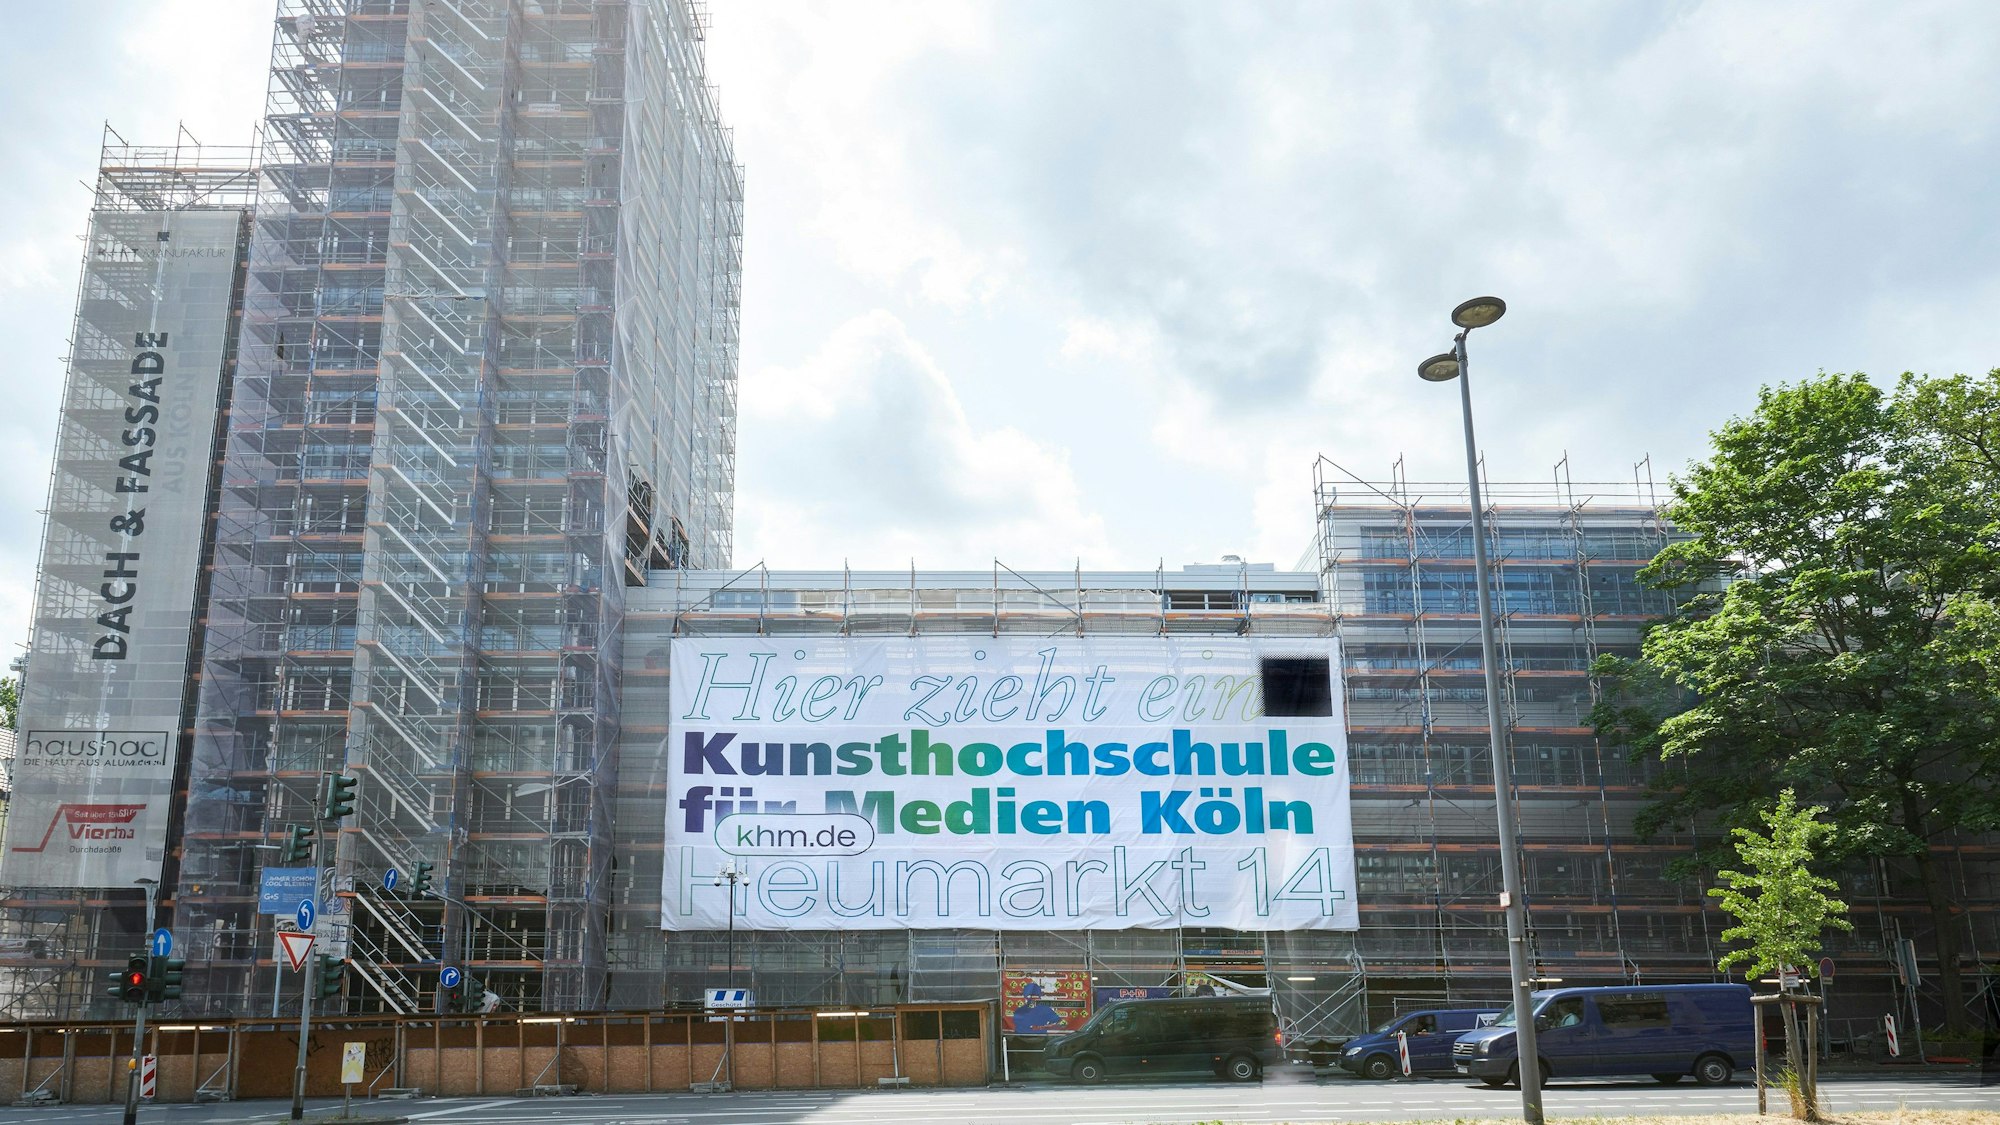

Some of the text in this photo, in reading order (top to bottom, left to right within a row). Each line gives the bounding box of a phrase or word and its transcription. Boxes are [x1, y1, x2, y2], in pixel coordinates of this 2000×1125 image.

[161, 371, 195, 495] AUS KÖLN
[92, 331, 169, 660] DACH & FASSADE
[682, 646, 1267, 727] Hier zieht ein
[23, 758, 41, 767] DIE
[45, 758, 74, 767] HAUT
[78, 758, 100, 767] AUS
[683, 729, 1336, 777] Kunsthochschule
[824, 787, 1111, 835] Medien
[1140, 786, 1315, 835] Köln
[736, 824, 856, 848] khm.de
[679, 845, 1346, 918] Heumarkt 14
[1119, 988, 1148, 998] P+M
